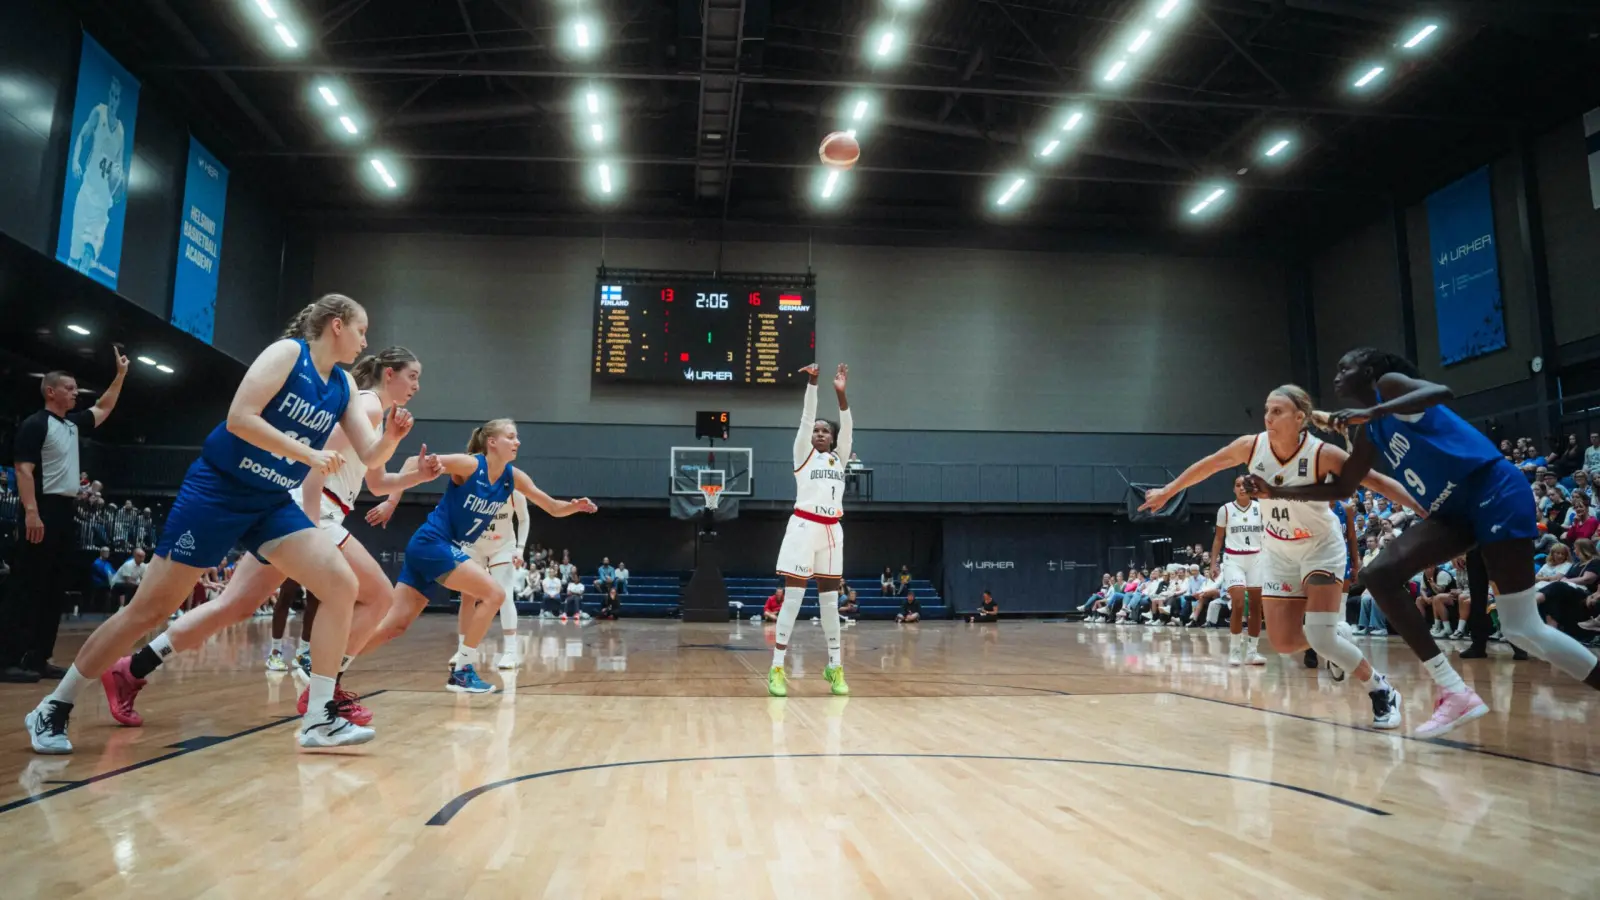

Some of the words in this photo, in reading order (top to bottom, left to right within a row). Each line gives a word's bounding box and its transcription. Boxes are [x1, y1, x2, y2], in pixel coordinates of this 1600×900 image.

[190, 205, 216, 236] HELSINKI
[183, 220, 217, 258] BASKETBALL
[1450, 234, 1491, 261] URHEA
[185, 243, 213, 274] ACADEMY
[661, 289, 674, 302] 13
[695, 293, 729, 309] 2:06
[748, 292, 761, 306] 16
[727, 351, 733, 361] 3
[695, 370, 733, 381] URHEA
[278, 392, 336, 433] FINLAN
[720, 413, 728, 422] 6
[1384, 431, 1411, 470] LAND
[239, 456, 300, 489] postnor
[1404, 468, 1426, 496] 9
[831, 486, 836, 500] 1
[463, 494, 505, 516] FINLAN
[815, 506, 835, 516] ING
[1271, 507, 1290, 522] 44
[465, 518, 482, 536] 7
[1244, 536, 1250, 546] 4
[794, 565, 808, 573] ING
[975, 560, 1014, 569] URHEA
[1263, 582, 1280, 591] ING
